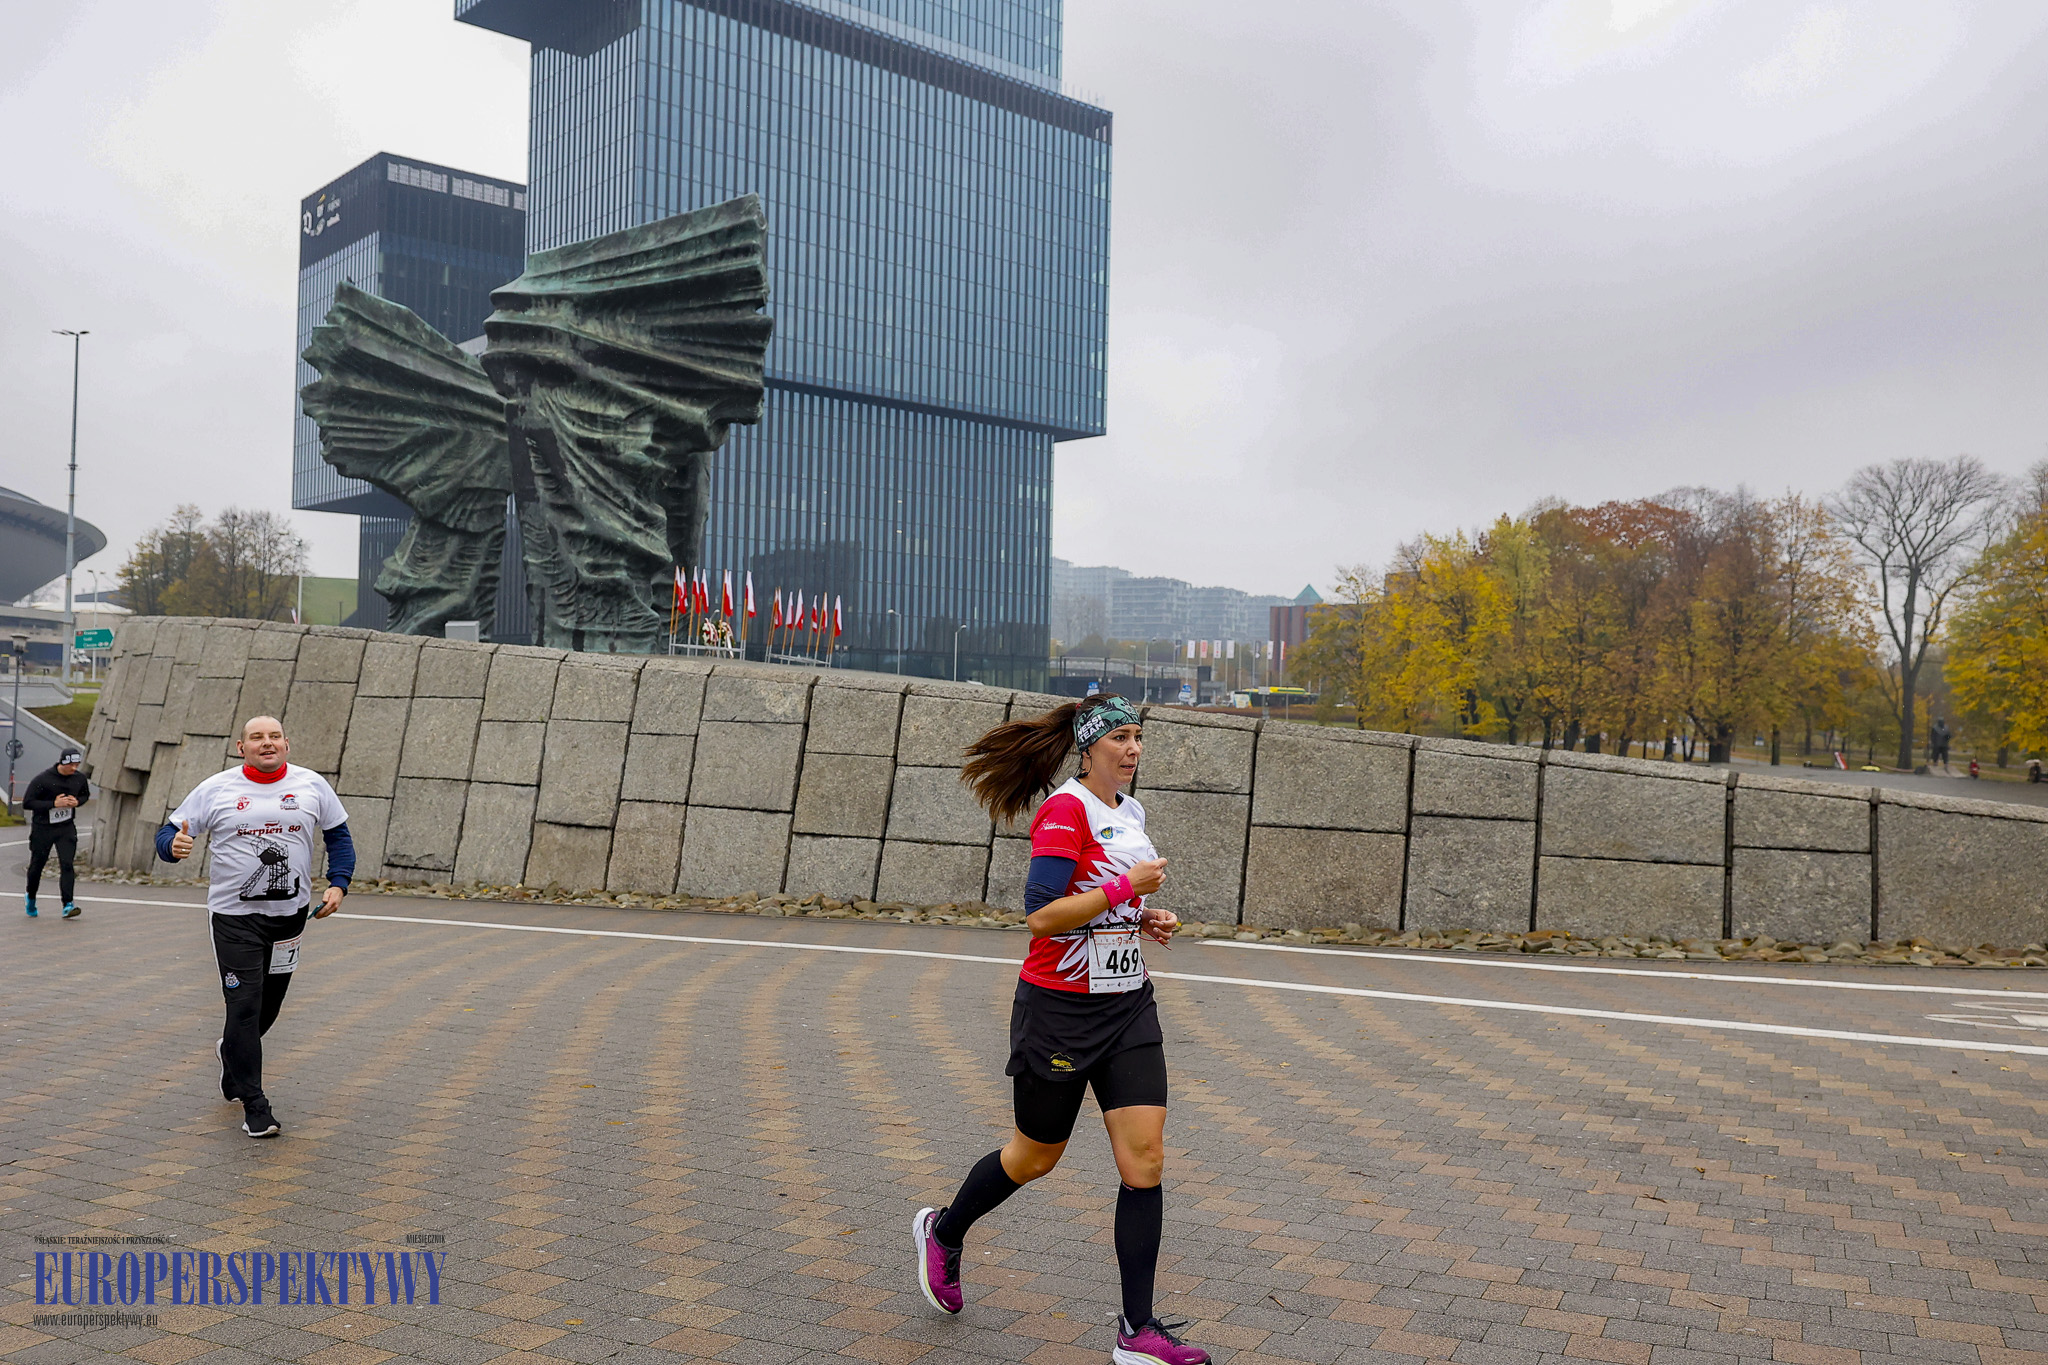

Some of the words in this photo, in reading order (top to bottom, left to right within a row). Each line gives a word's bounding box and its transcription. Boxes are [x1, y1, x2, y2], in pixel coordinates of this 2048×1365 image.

[1077, 714, 1102, 737] NESSI
[1078, 720, 1105, 743] TEAM
[236, 801, 250, 811] 87
[236, 825, 283, 837] Sierpień
[288, 824, 302, 832] 80
[1105, 947, 1139, 975] 469
[925, 1216, 934, 1239] HOKA
